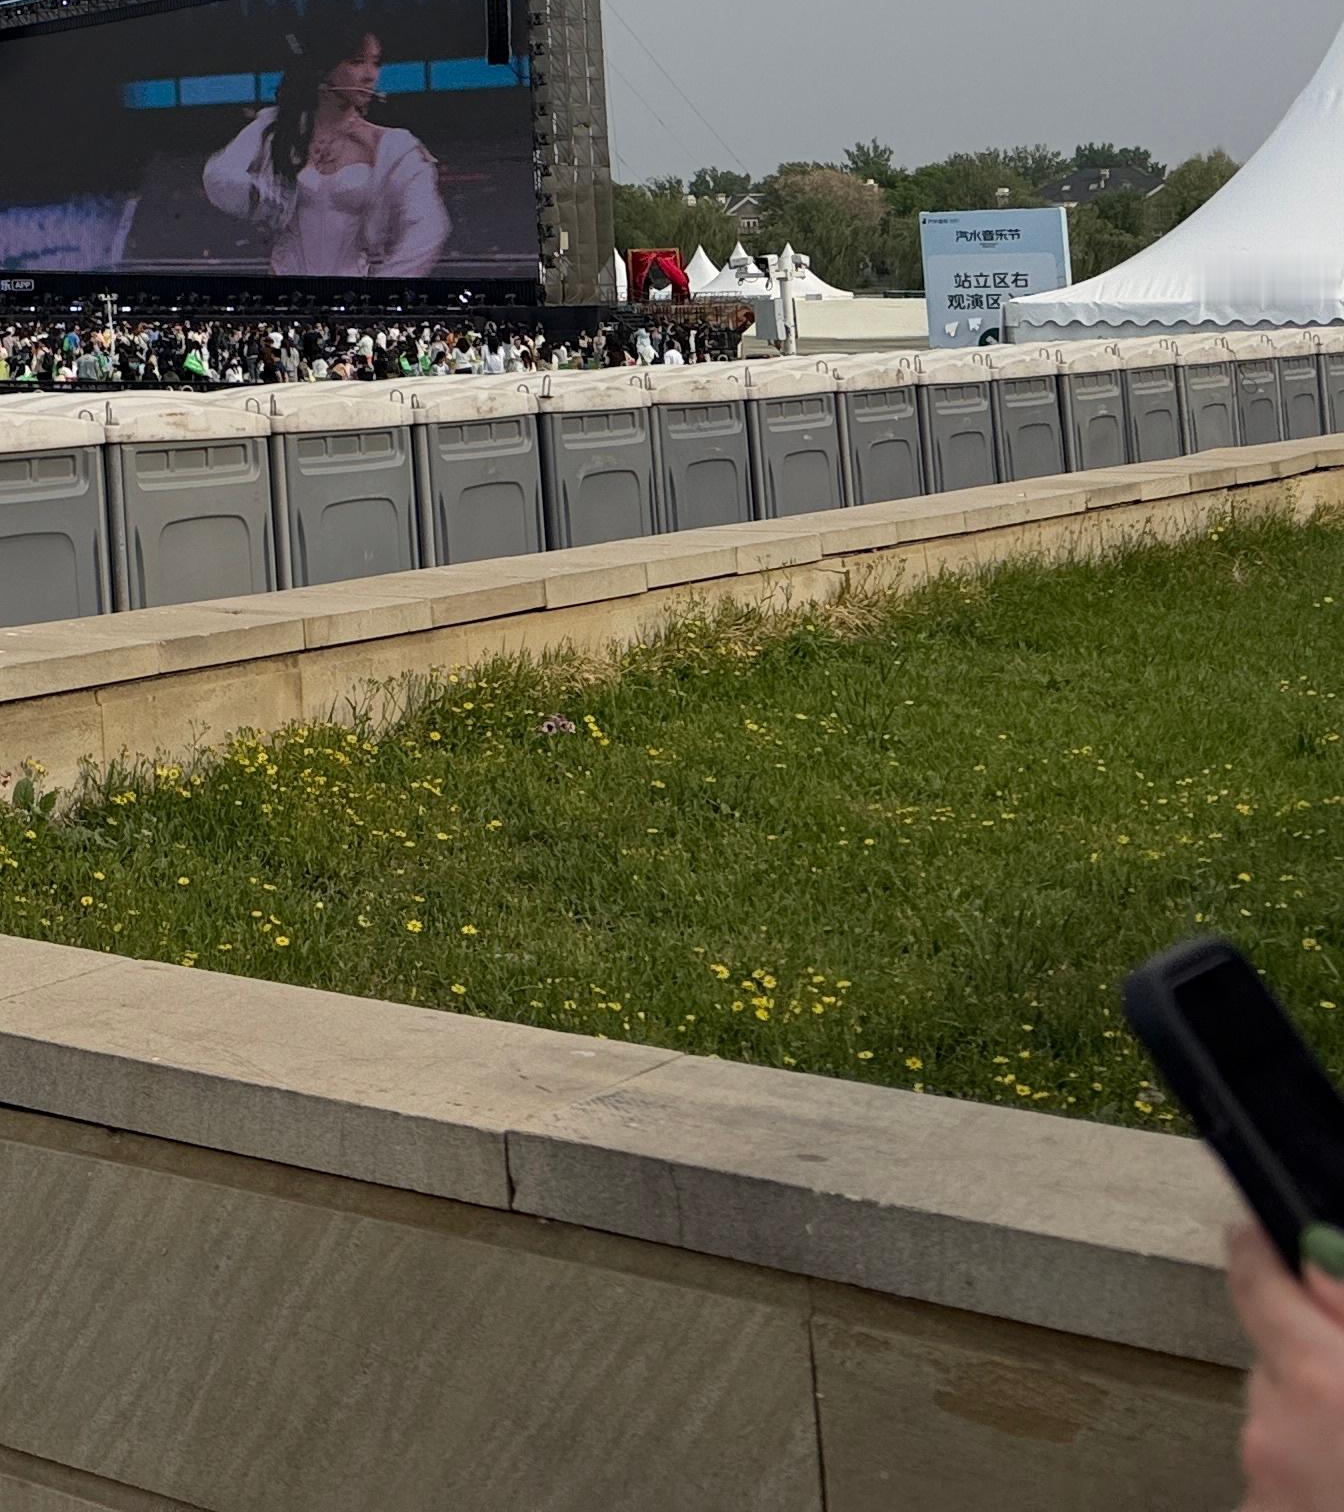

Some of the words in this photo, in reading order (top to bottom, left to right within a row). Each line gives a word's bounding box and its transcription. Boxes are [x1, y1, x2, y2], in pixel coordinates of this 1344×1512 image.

[955, 228, 1021, 242] 汽水音乐节
[954, 272, 1029, 289] 站立区右
